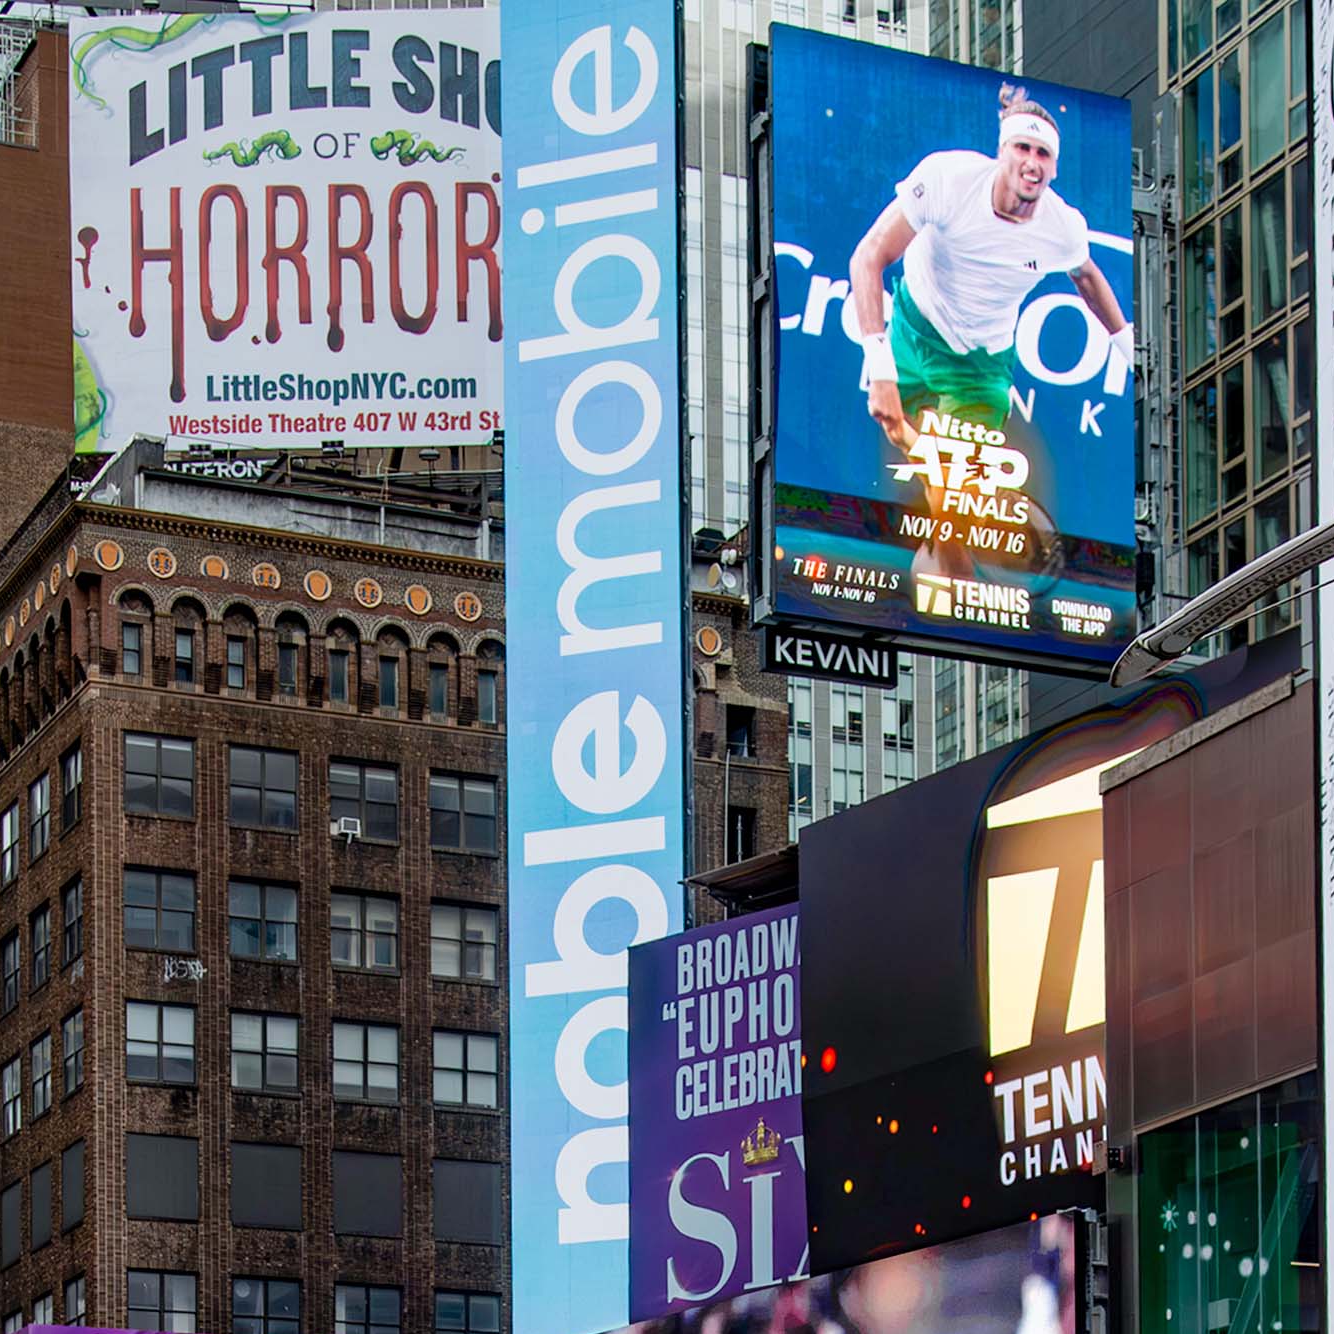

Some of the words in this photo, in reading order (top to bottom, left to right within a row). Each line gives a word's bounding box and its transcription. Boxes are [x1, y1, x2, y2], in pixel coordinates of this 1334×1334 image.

[129, 30, 370, 166] LITTLE
[313, 132, 361, 159] OF
[130, 181, 503, 390] HORROR
[517, 24, 663, 656] mobile
[206, 373, 477, 405] LittleShopNYC.com
[170, 414, 263, 436] Westside
[268, 412, 346, 434] Theatre
[353, 412, 391, 432] 407
[398, 411, 417, 431] W
[424, 410, 471, 431] 43rd
[478, 409, 500, 430] St
[920, 410, 1006, 446] Nitto
[887, 434, 1029, 496] ATP
[942, 490, 1029, 525] FINALS
[900, 514, 935, 539] NOV
[939, 522, 952, 541] 9
[967, 525, 1004, 552] NOV
[1006, 531, 1025, 554] 16
[793, 557, 827, 580] THE
[834, 564, 900, 591] FINALS
[812, 582, 834, 597] NOV
[834, 585, 863, 602] 1-NOV
[863, 590, 875, 604] 16
[952, 579, 1030, 615] TENNIS
[1052, 599, 1112, 622] DOWNLOAD
[955, 605, 1030, 630] CHANNEL
[1061, 617, 1082, 634] THE
[1083, 619, 1106, 637] APP
[774, 635, 890, 678] KEVANI
[524, 690, 668, 1245] noble
[678, 916, 800, 995] BROADW
